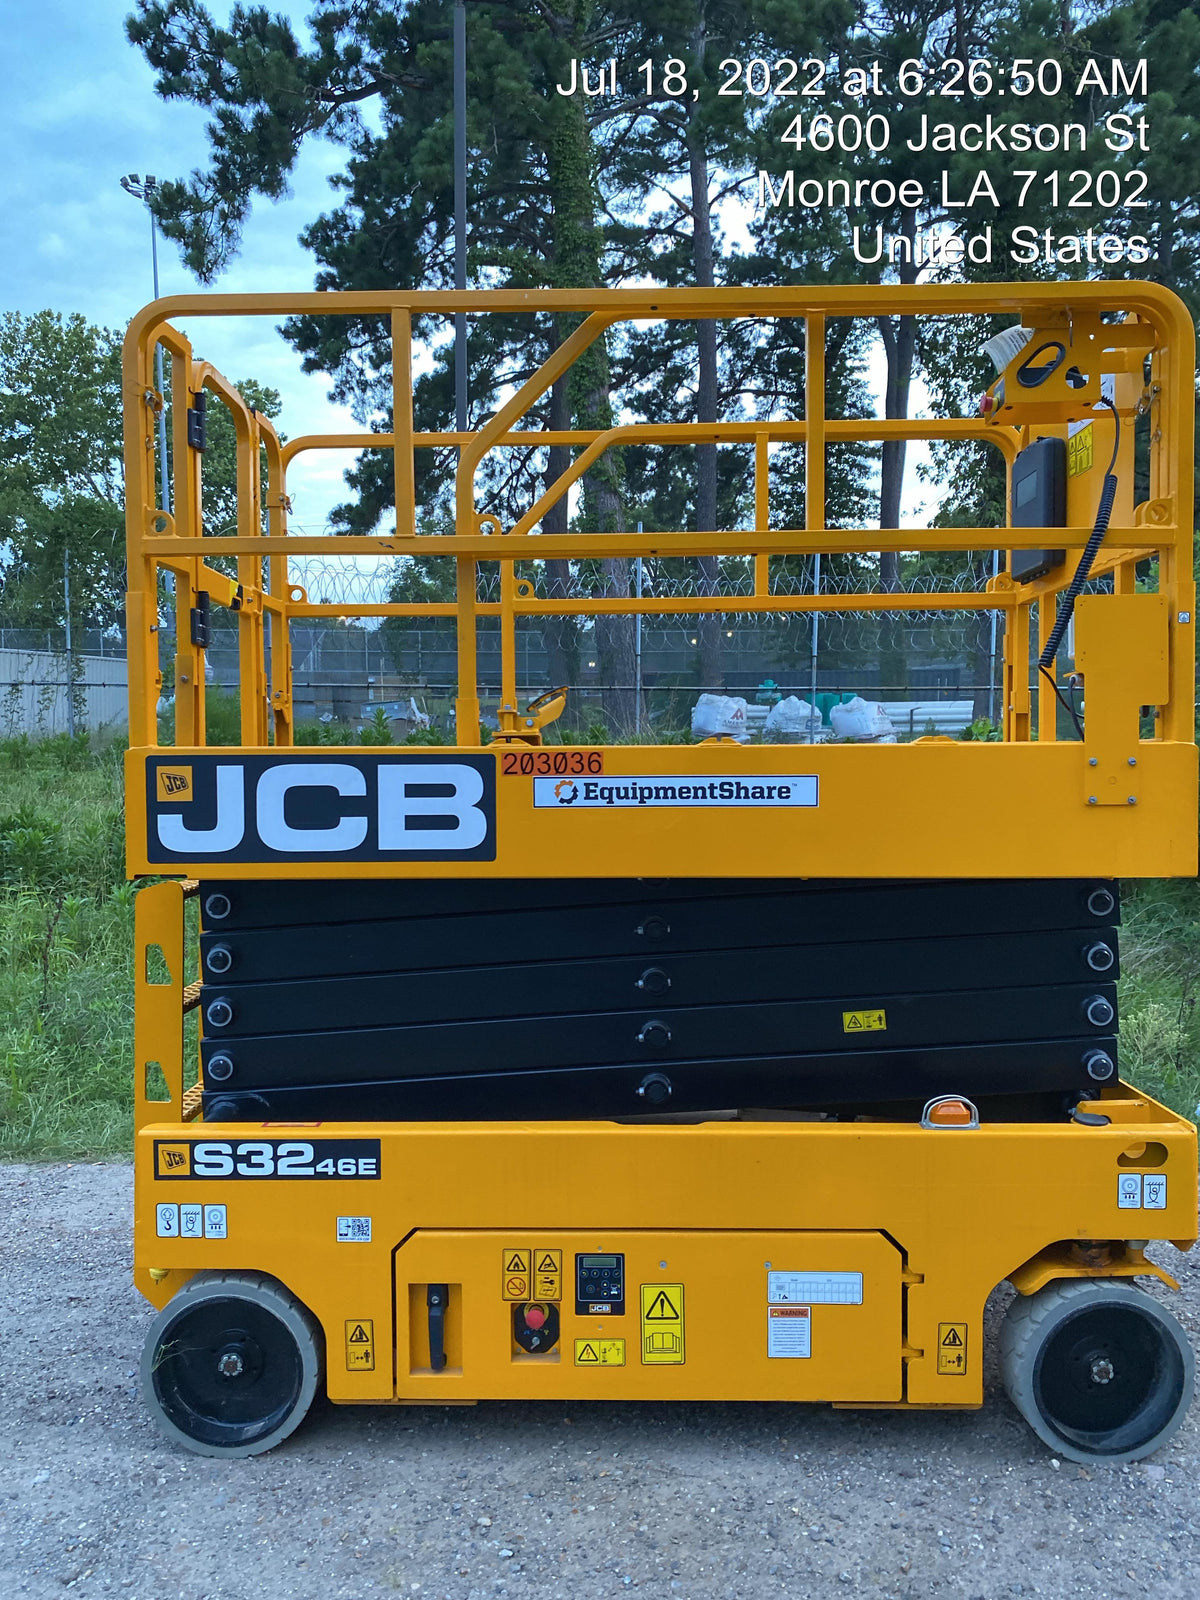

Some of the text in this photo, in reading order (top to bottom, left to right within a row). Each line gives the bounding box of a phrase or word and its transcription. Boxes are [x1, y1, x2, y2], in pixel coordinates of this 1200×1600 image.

[503, 753, 602, 775] 203036
[161, 771, 189, 795] JCB
[584, 781, 791, 804] EquipmentShare
[157, 763, 487, 853] JCB
[165, 1151, 186, 1168] JCB
[194, 1143, 315, 1176] S32
